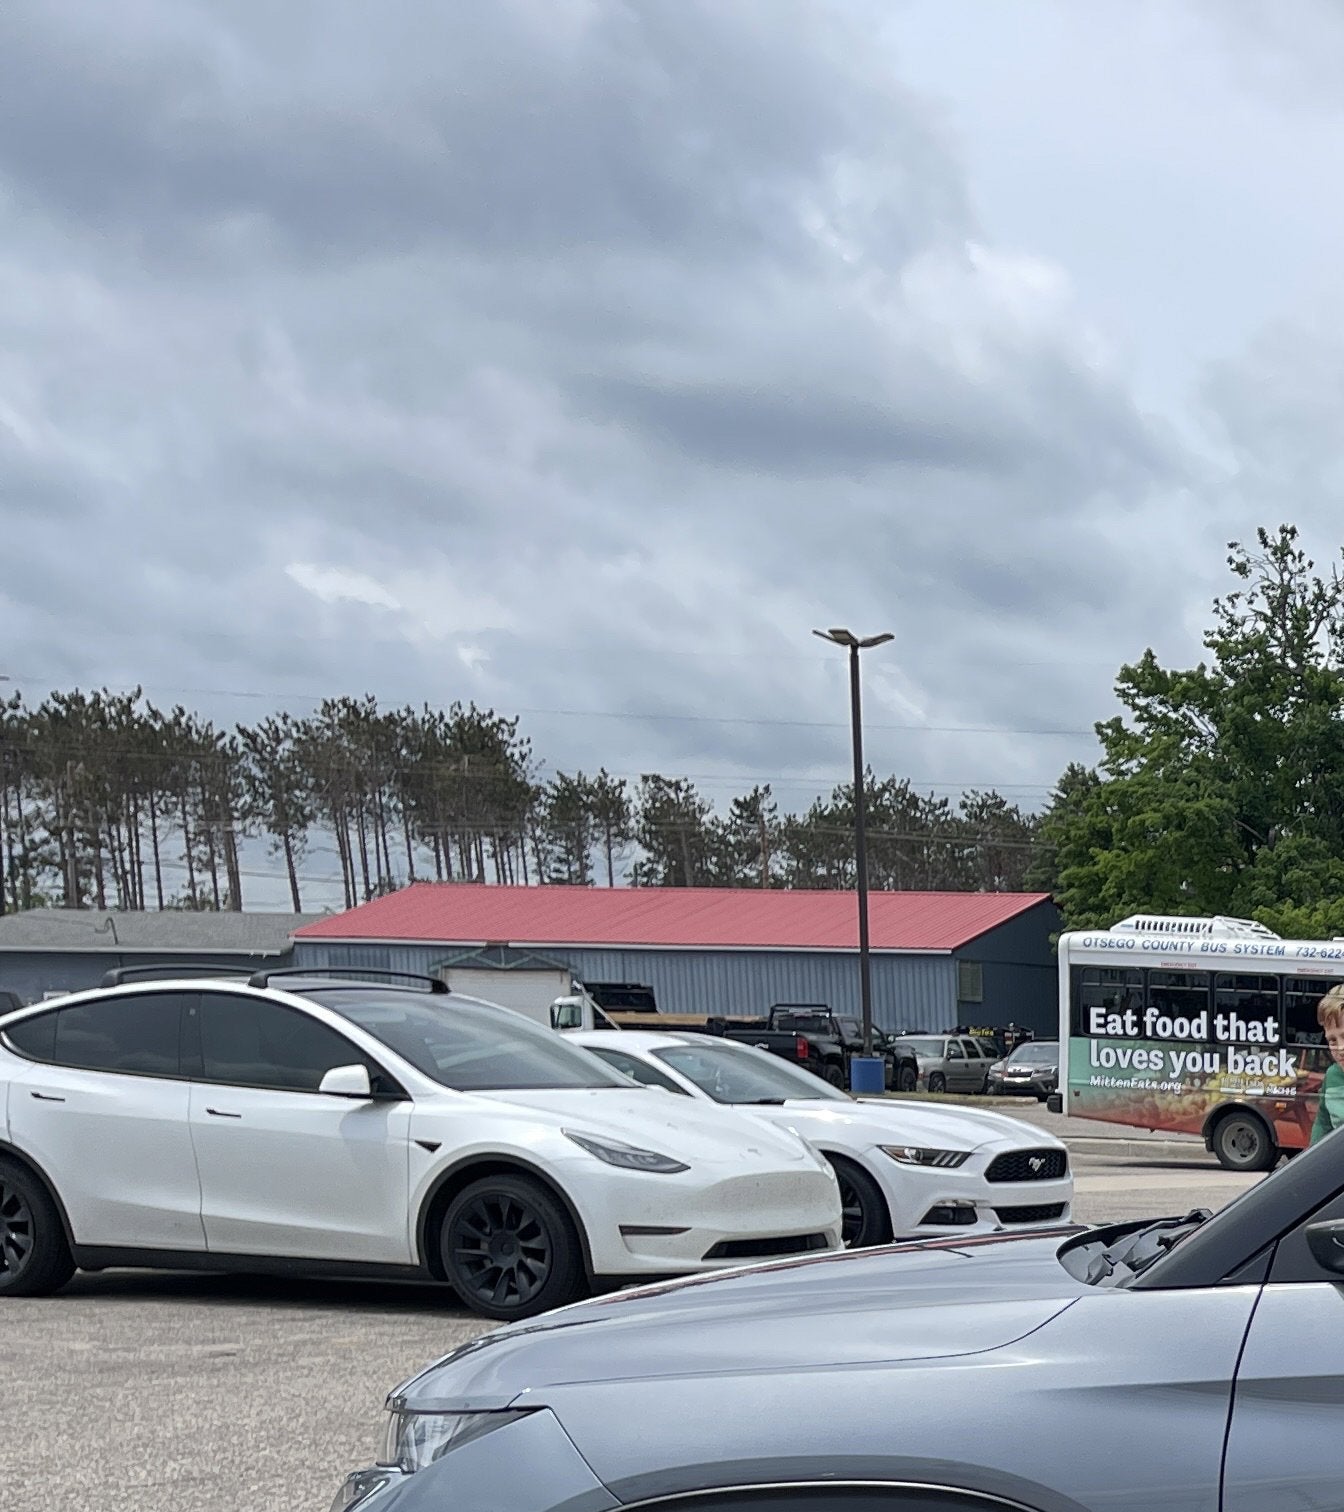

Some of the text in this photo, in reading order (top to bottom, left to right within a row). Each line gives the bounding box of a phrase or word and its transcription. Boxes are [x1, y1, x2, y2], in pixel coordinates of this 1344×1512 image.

[1083, 937, 1136, 950] OTSEGO
[1142, 940, 1195, 952] COUNTY
[1201, 942, 1227, 953] BUS
[1234, 944, 1286, 957] SYSTEM
[1089, 1006, 1280, 1043] Eat food that
[1090, 1039, 1298, 1079] loves you back
[1089, 1074, 1183, 1094] MittenEats.org
